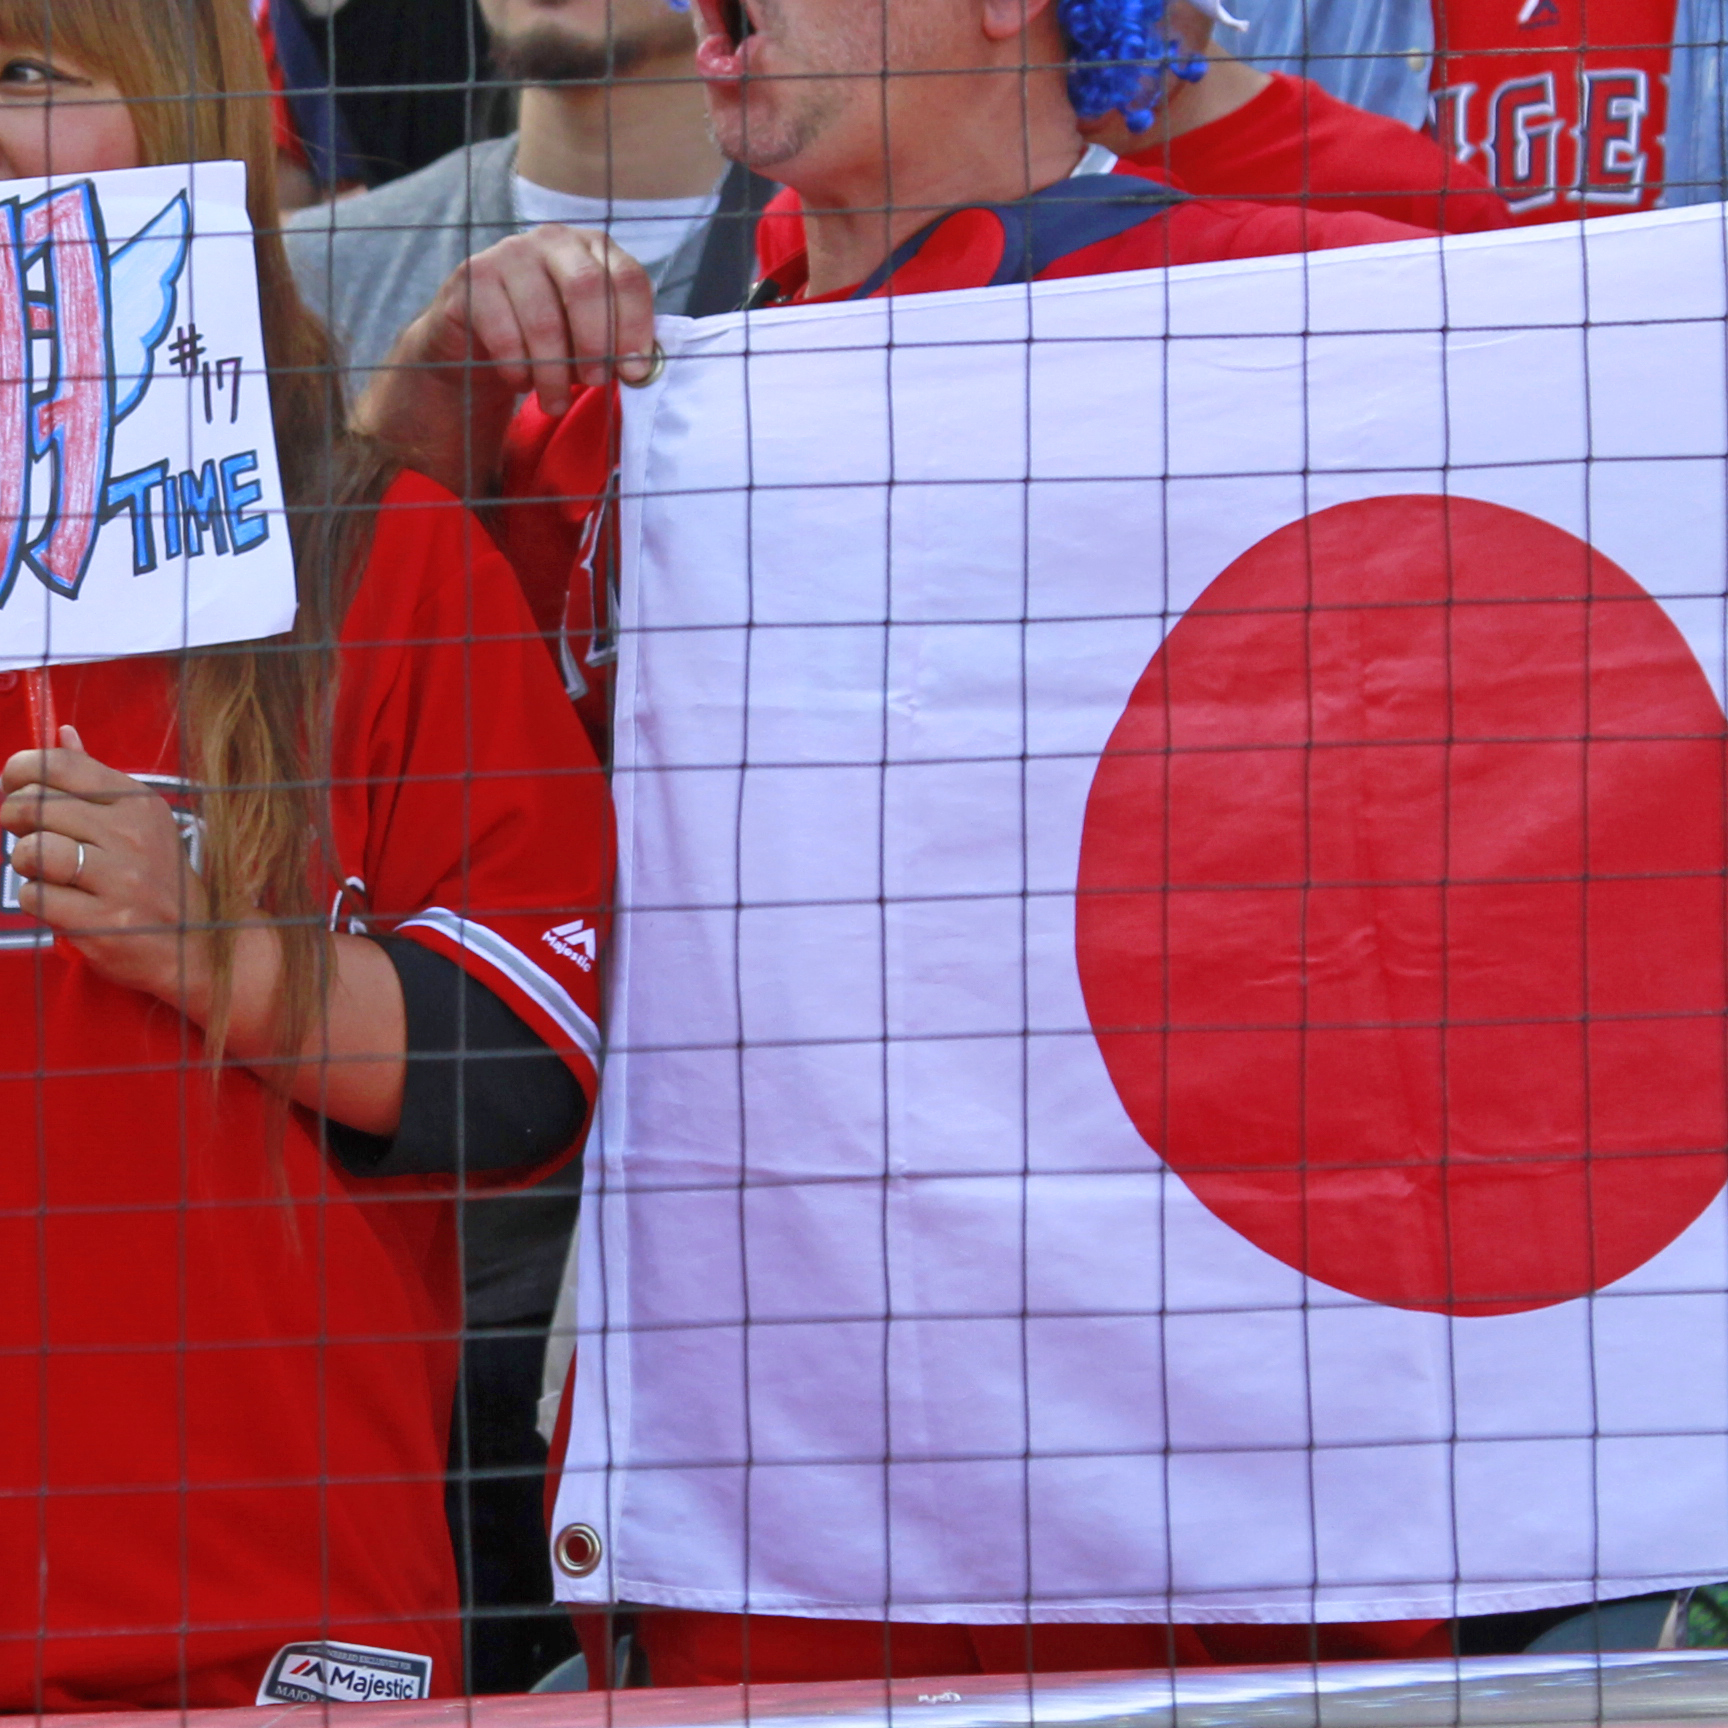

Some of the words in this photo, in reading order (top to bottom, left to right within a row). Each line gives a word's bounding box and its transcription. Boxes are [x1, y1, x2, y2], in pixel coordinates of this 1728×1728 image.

[168, 323, 243, 424] #17
[100, 449, 270, 577] TIME
[540, 930, 592, 973] Majestic
[329, 1666, 414, 1701] Majestic
